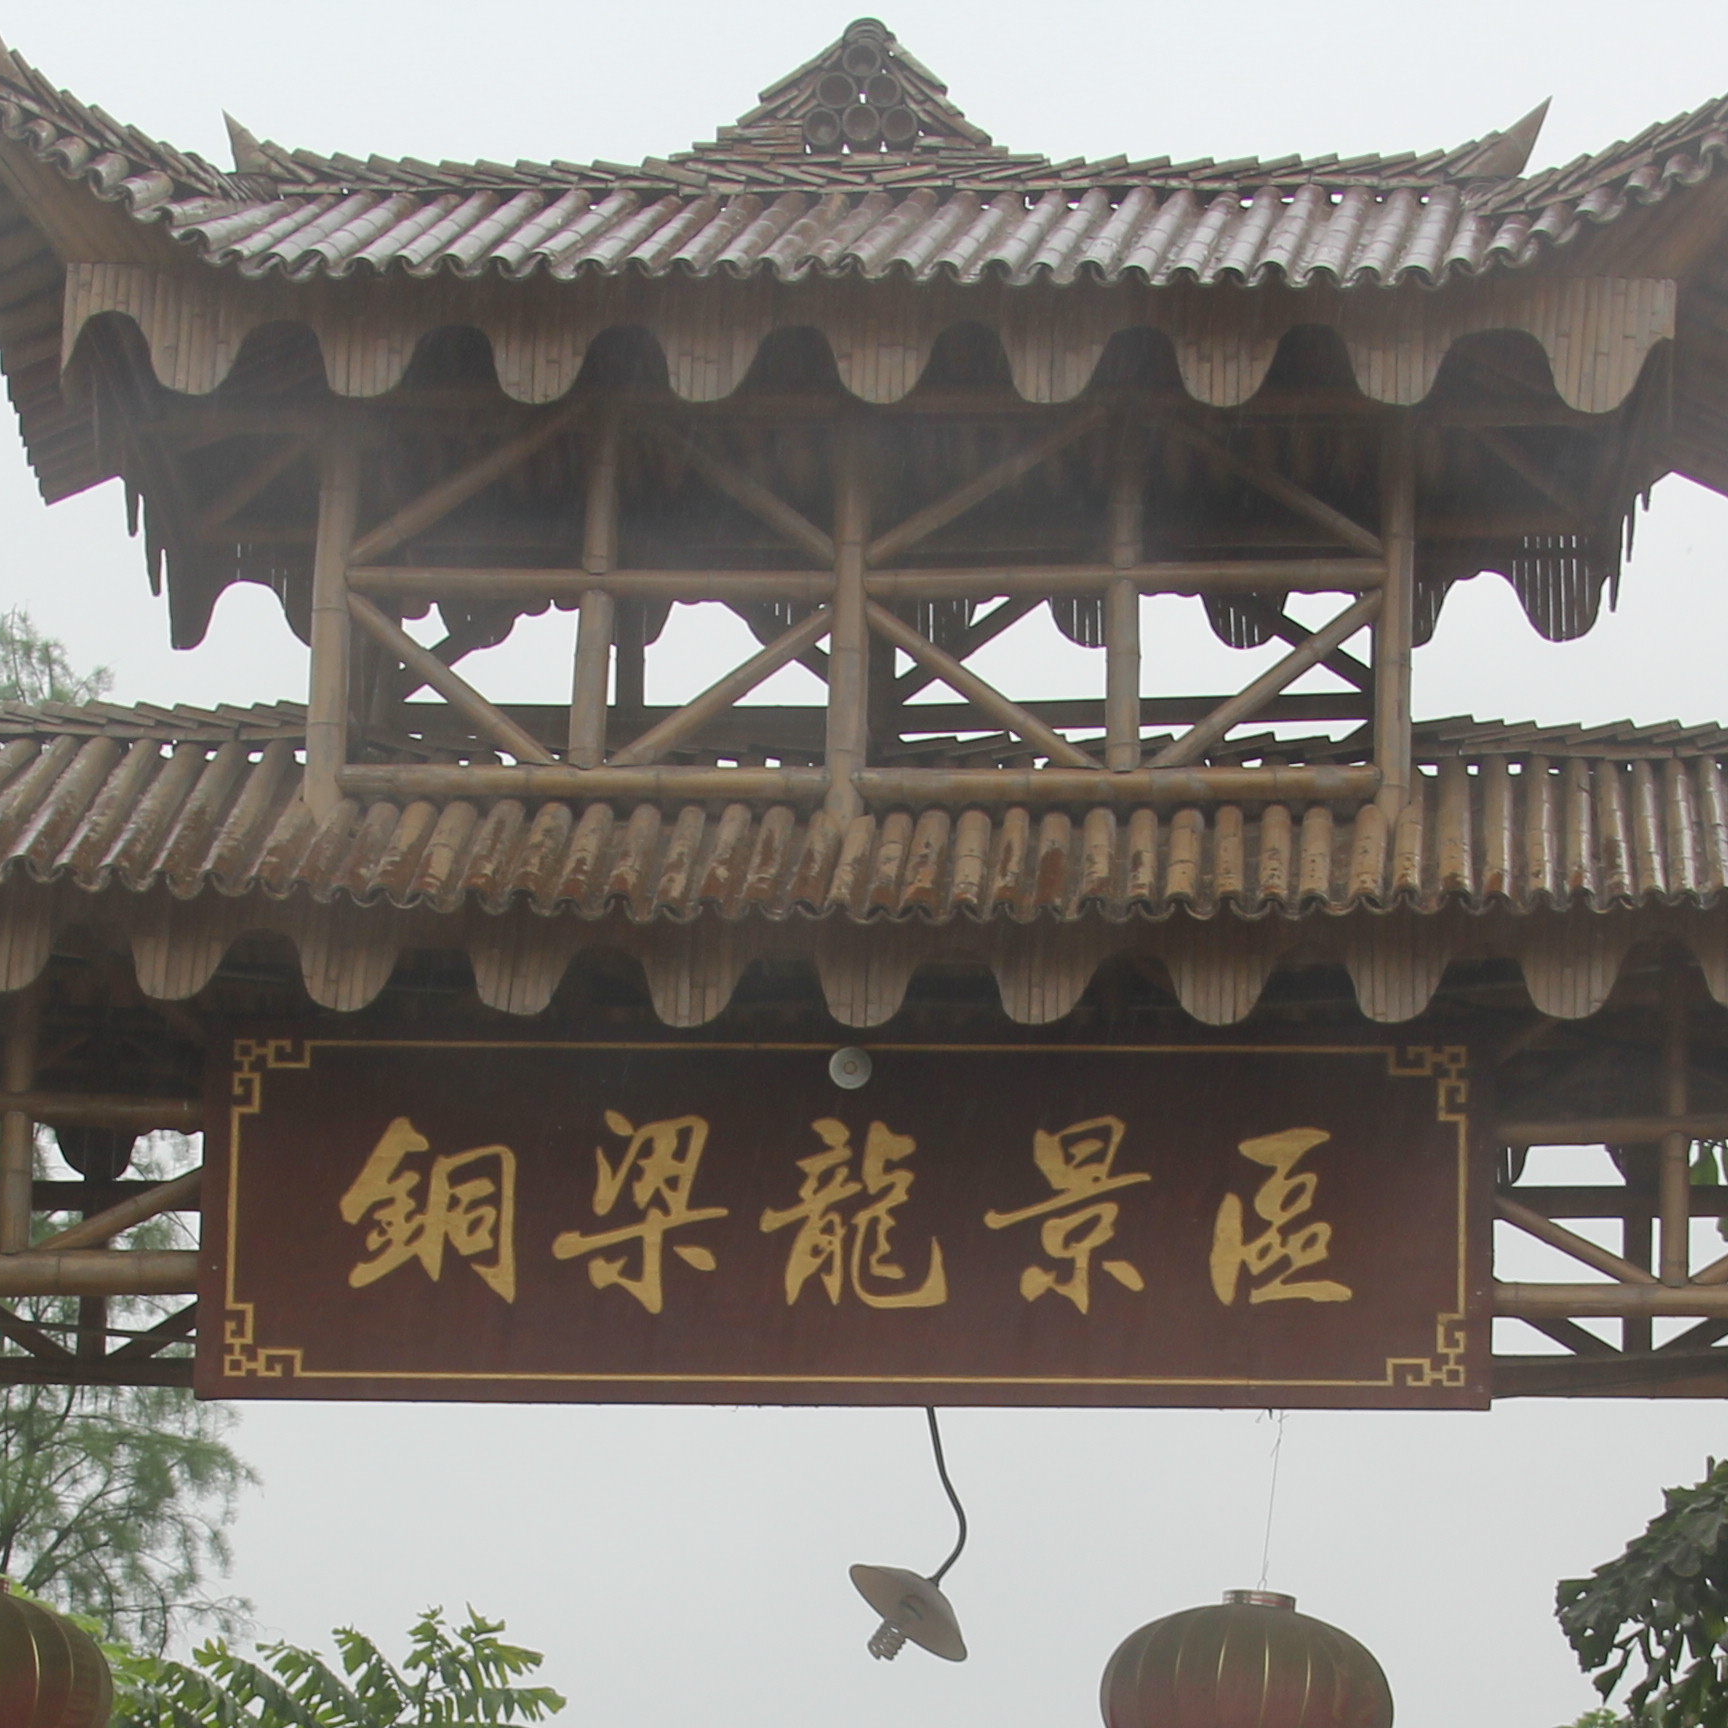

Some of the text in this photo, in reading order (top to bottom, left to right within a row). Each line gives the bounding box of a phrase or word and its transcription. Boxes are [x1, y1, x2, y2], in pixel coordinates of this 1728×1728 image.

[339, 1109, 1354, 1313] 銅梁龍景區
